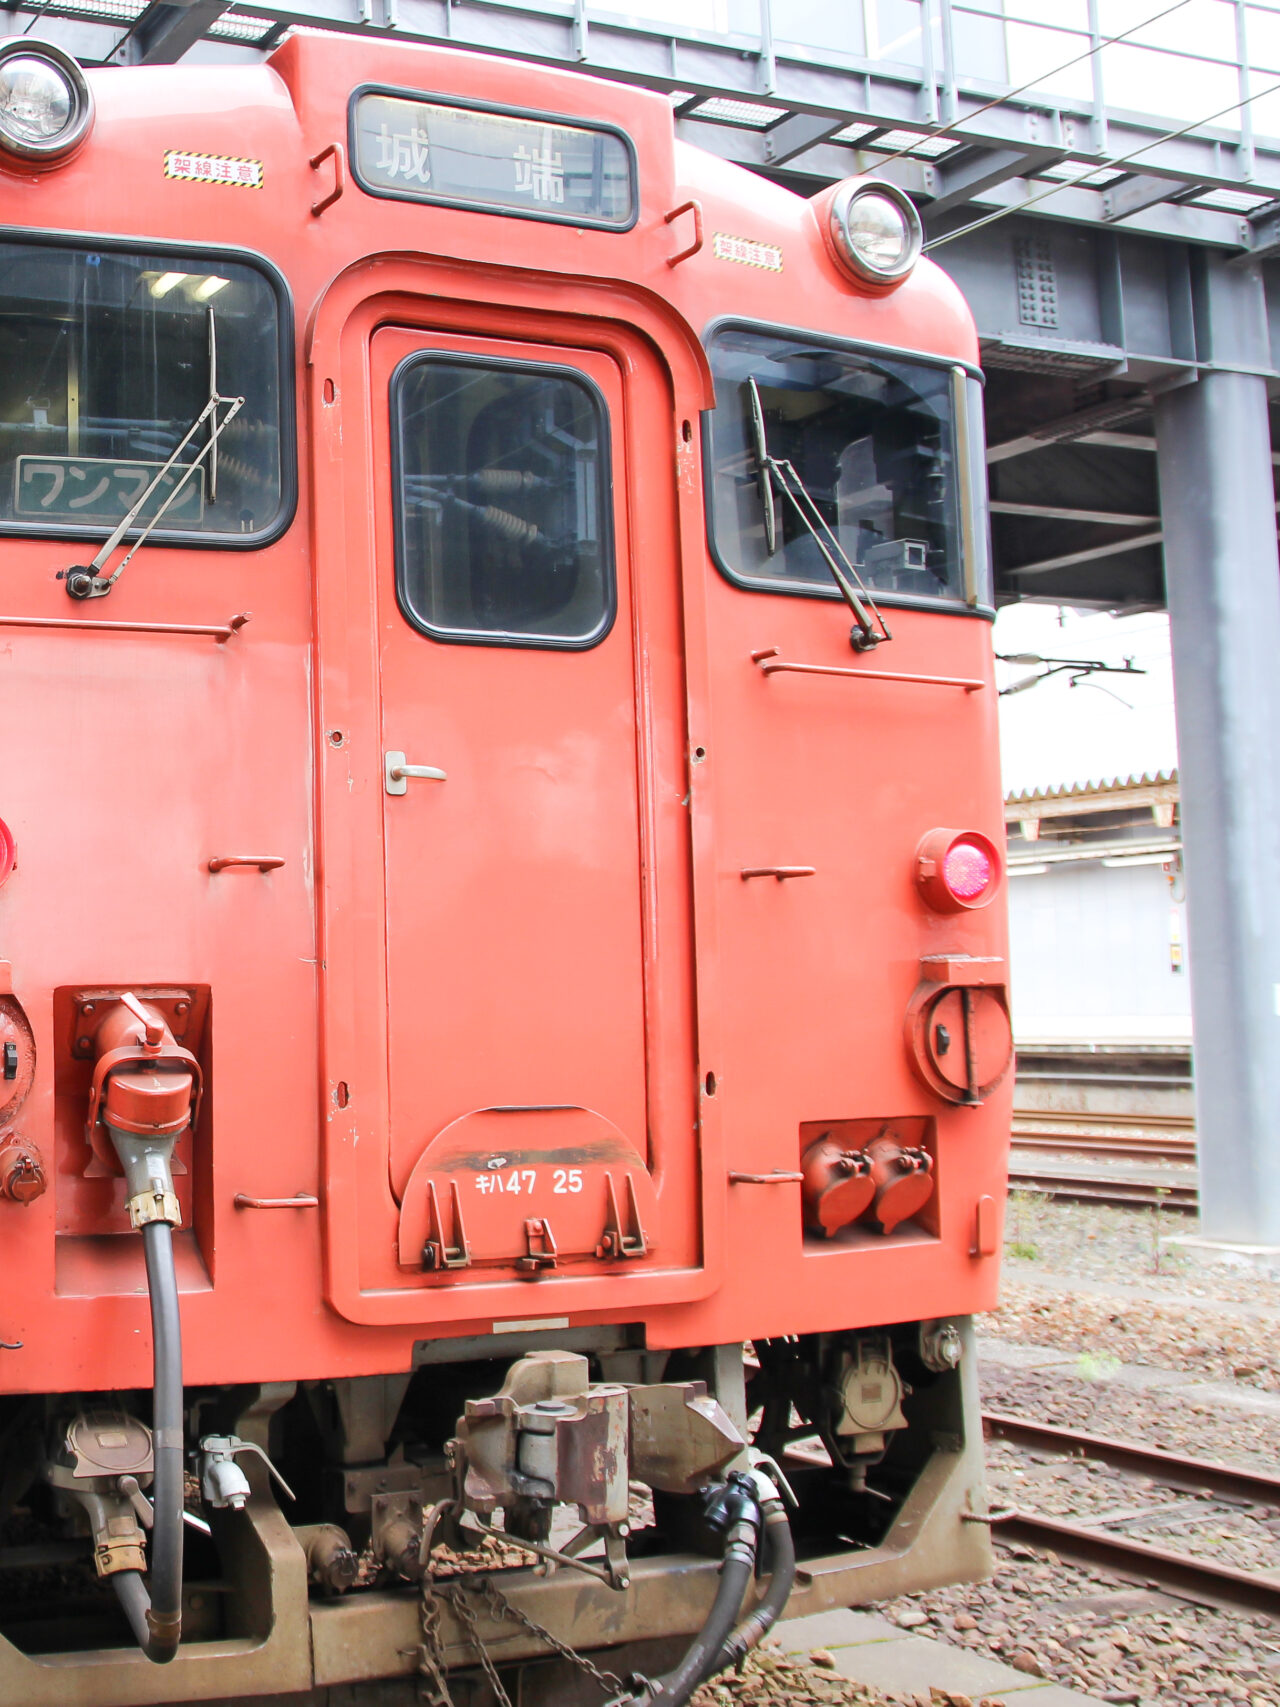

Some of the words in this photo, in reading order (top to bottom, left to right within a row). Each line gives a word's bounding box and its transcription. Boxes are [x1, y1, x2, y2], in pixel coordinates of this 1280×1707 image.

[174, 157, 253, 182] 架線注意
[720, 240, 776, 266] 架線注意
[23, 463, 197, 512] ワンマン
[475, 1170, 536, 1195] キハ47
[553, 1169, 583, 1194] 25
